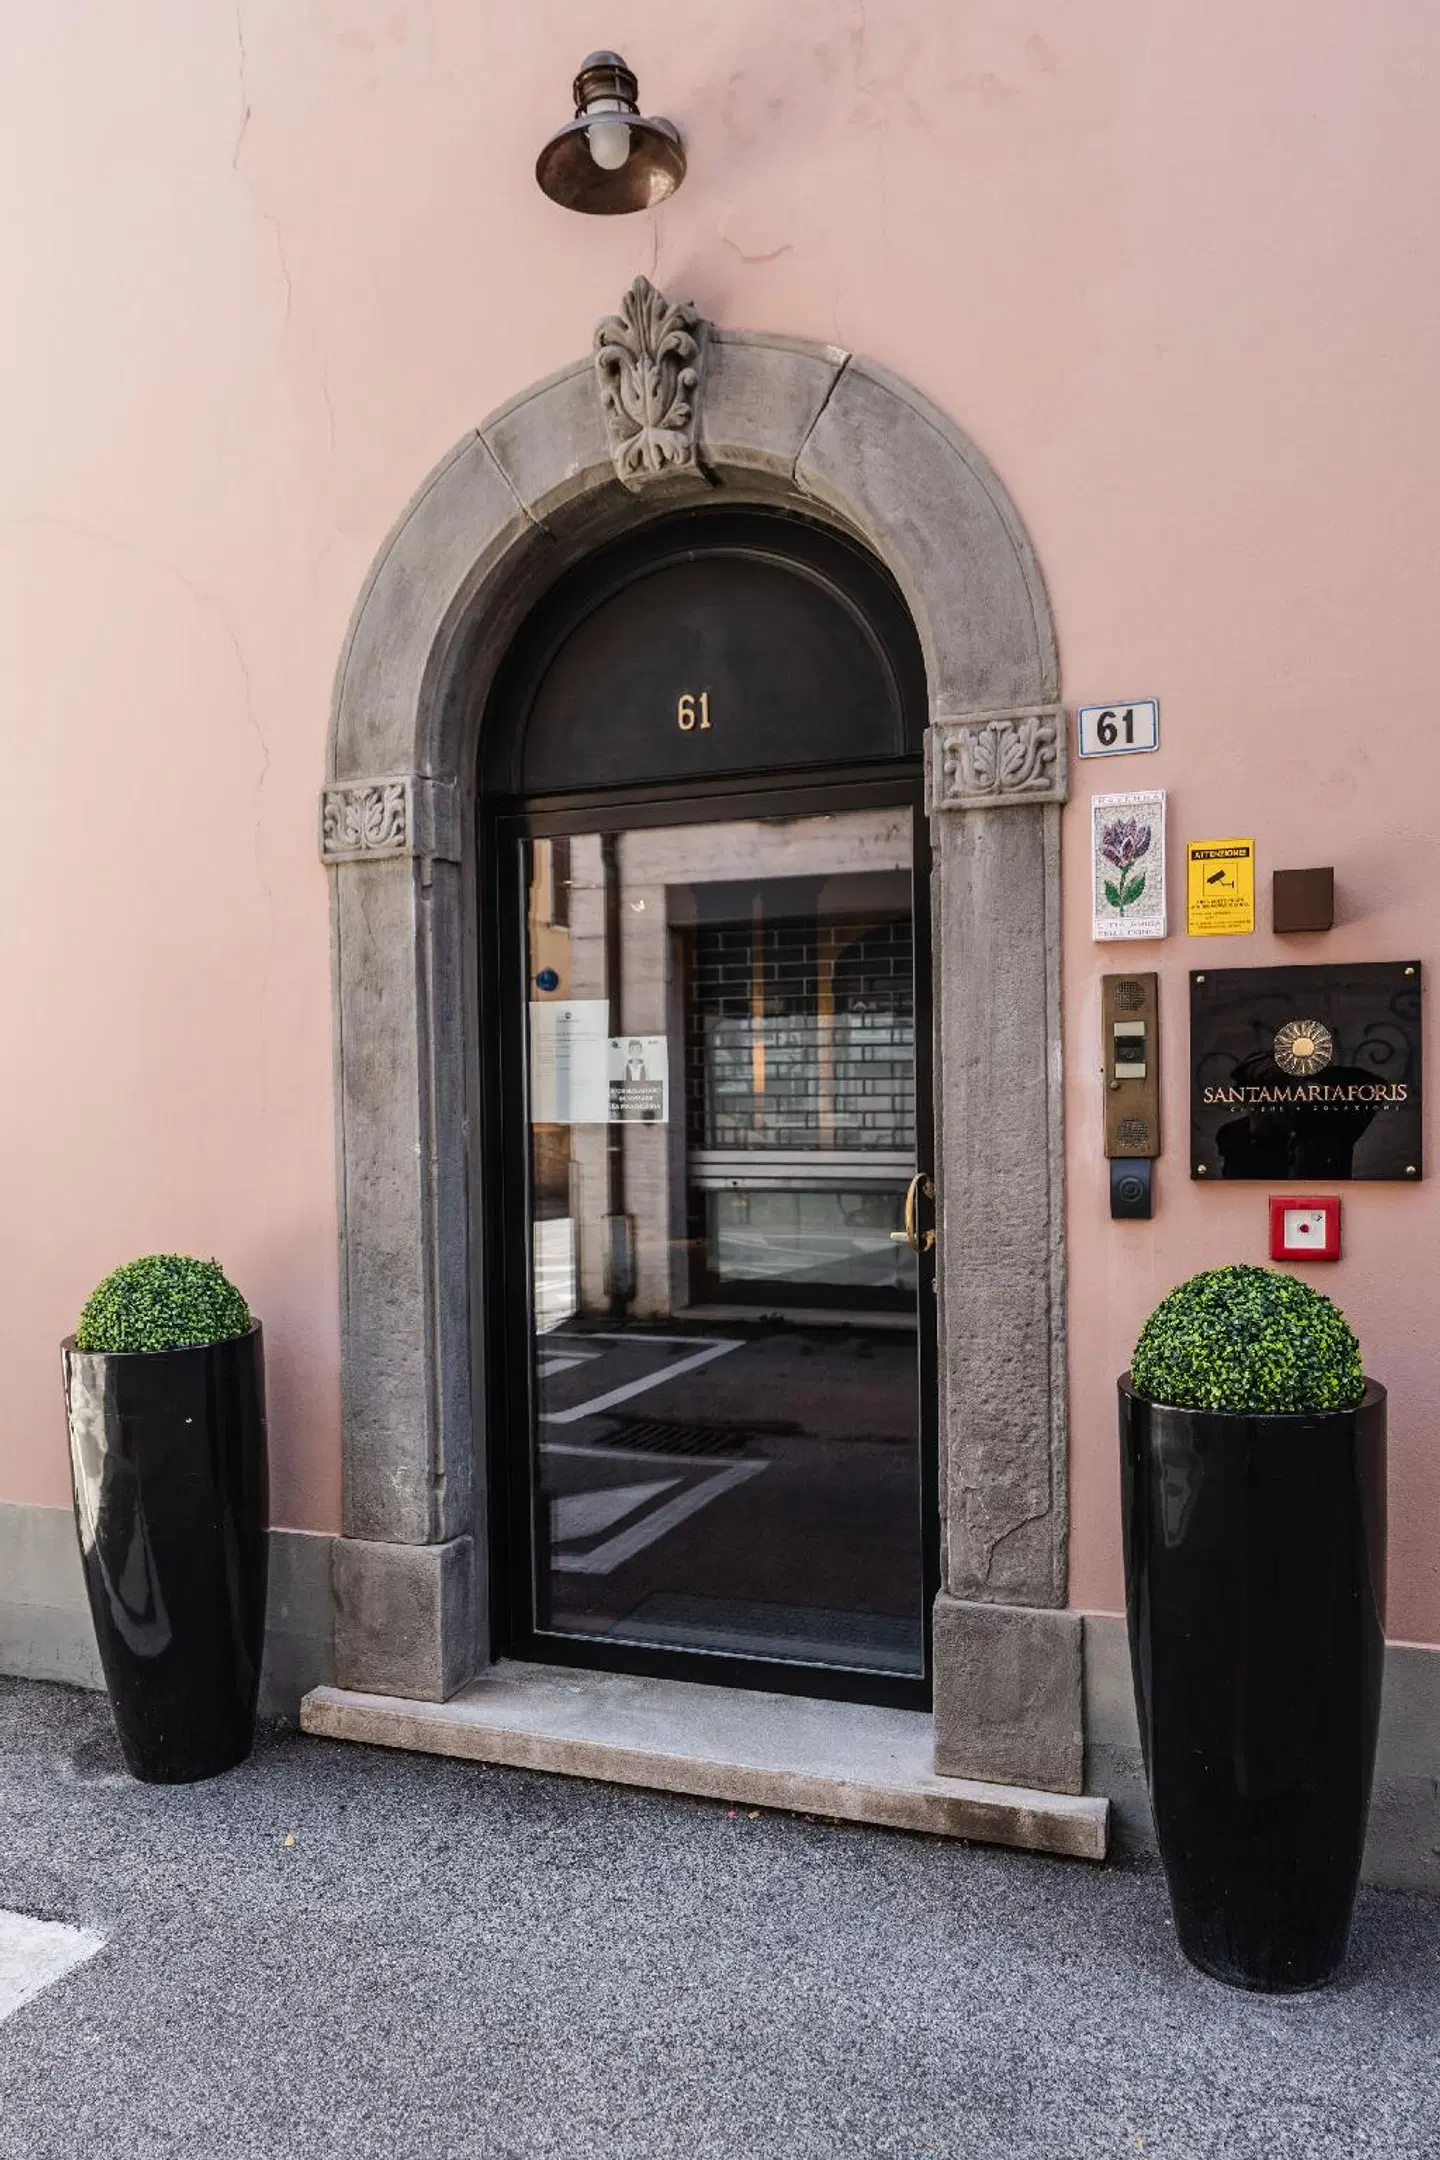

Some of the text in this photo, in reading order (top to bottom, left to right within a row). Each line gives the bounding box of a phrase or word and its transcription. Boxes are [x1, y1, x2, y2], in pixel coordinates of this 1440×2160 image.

[678, 692, 710, 730] 61
[1097, 709, 1133, 746] 61
[1203, 1083, 1408, 1104] SANTAMARIAFORIS
